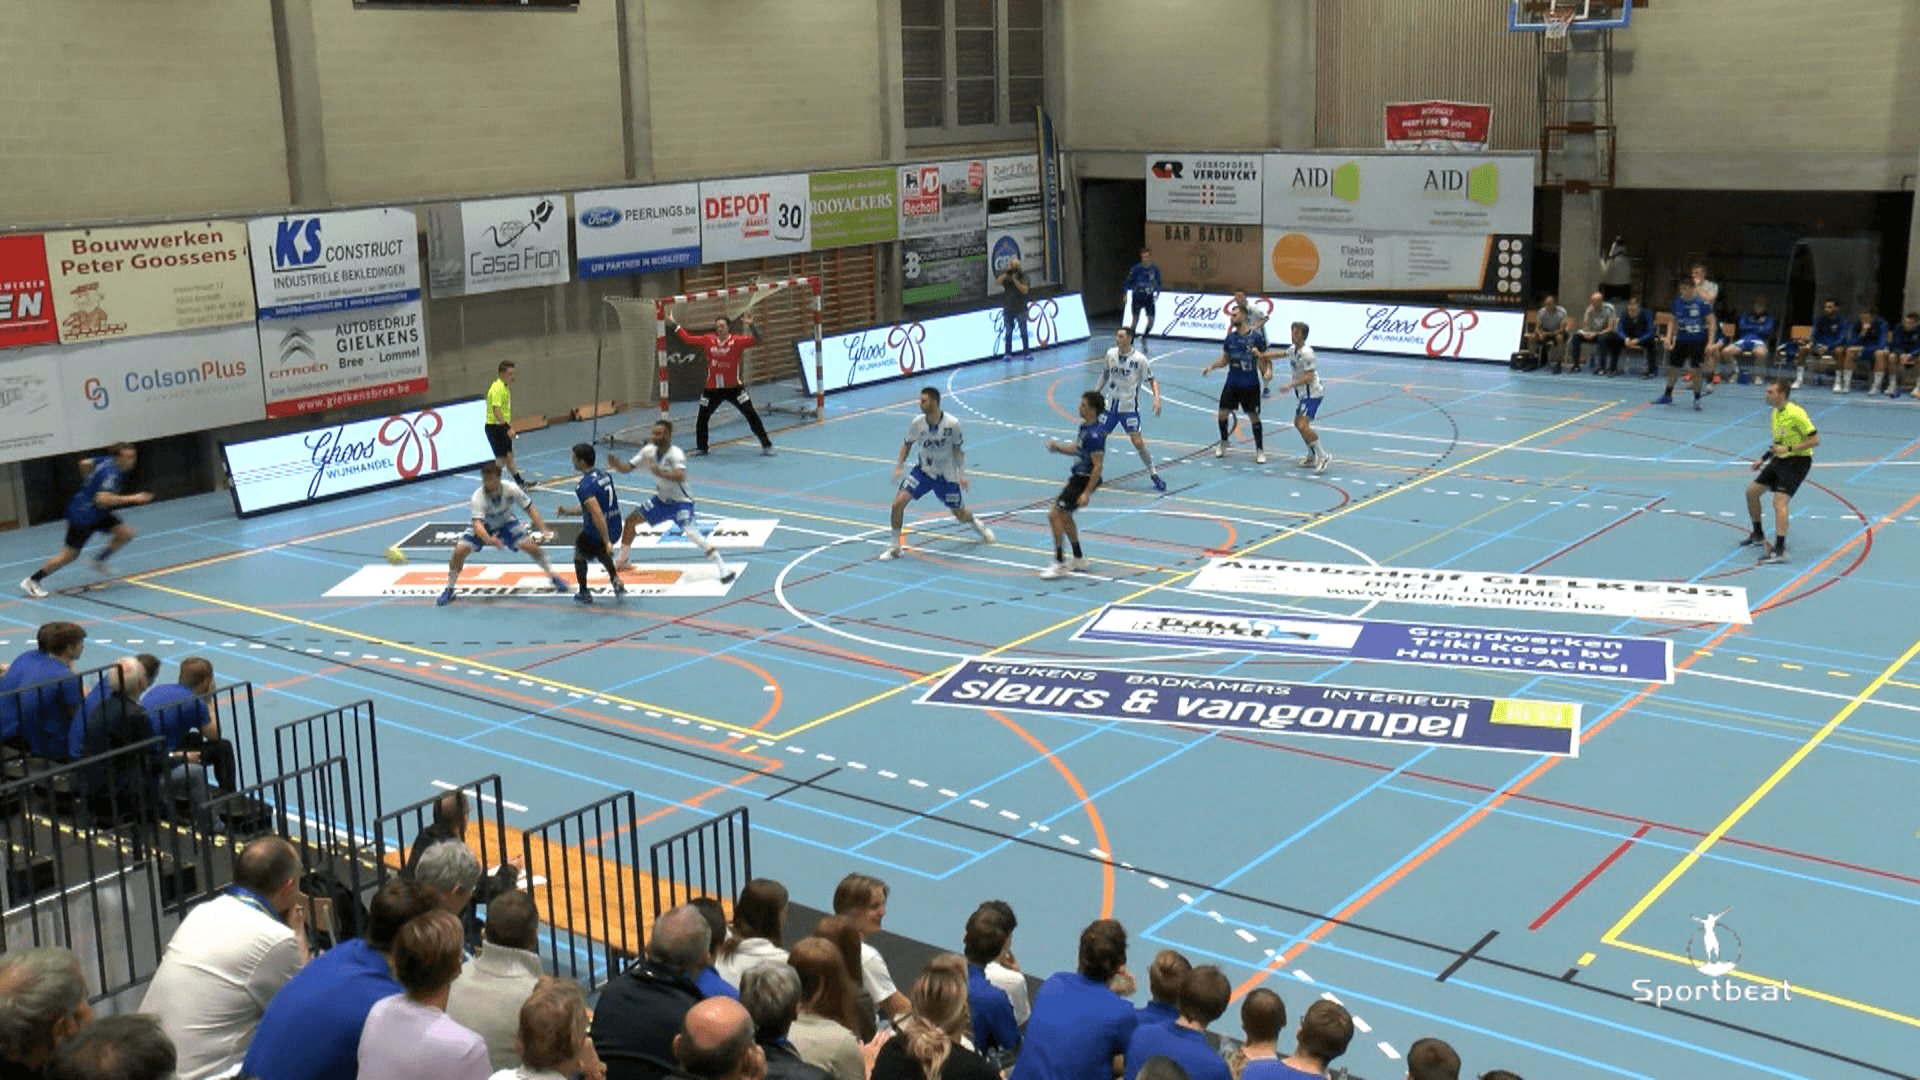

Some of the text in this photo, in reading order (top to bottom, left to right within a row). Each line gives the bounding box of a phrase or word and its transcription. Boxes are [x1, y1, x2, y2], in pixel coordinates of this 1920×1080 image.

[1193, 169, 1257, 181] VERDUYCKT
[1292, 167, 1328, 189] AID
[1423, 169, 1463, 191] AID
[625, 205, 696, 220] PEERLINGS.be
[705, 192, 770, 220] DEPOT
[778, 203, 802, 229] 30
[71, 230, 223, 255] Bouwwerken
[275, 217, 322, 267] KS
[1165, 226, 1190, 241] BAR
[60, 249, 237, 276] Peter Goossens
[325, 239, 403, 262] CONSTRUCT
[470, 251, 520, 277] Casa
[273, 264, 405, 289] INDUSTRIELE BEKLEDINGEN
[335, 313, 417, 337] AUTOBEDRIJF
[336, 328, 419, 352] GIELKENS
[339, 356, 365, 369] Bree
[379, 347, 420, 363] Lommel
[124, 360, 247, 393] ColsonPlus
[297, 382, 410, 411] www.gielkensbree.be
[304, 425, 375, 499] Ghoos
[326, 458, 394, 479] WIJNHANDEL
[1218, 561, 1733, 597] Autobedrijf GIELKENS
[1365, 580, 1437, 591] BREE
[1463, 585, 1580, 600] LOMMEL
[1326, 588, 1605, 610] www.gielkensbree.be
[1408, 627, 1623, 649] Grondwerken
[1411, 637, 1620, 659] Triki Koen bv
[1395, 648, 1629, 673] Hamont-Achel
[977, 663, 1471, 709] KEUKENS BADKAMERS INTERIEUR
[952, 677, 1468, 738] sleurs & vangompel
